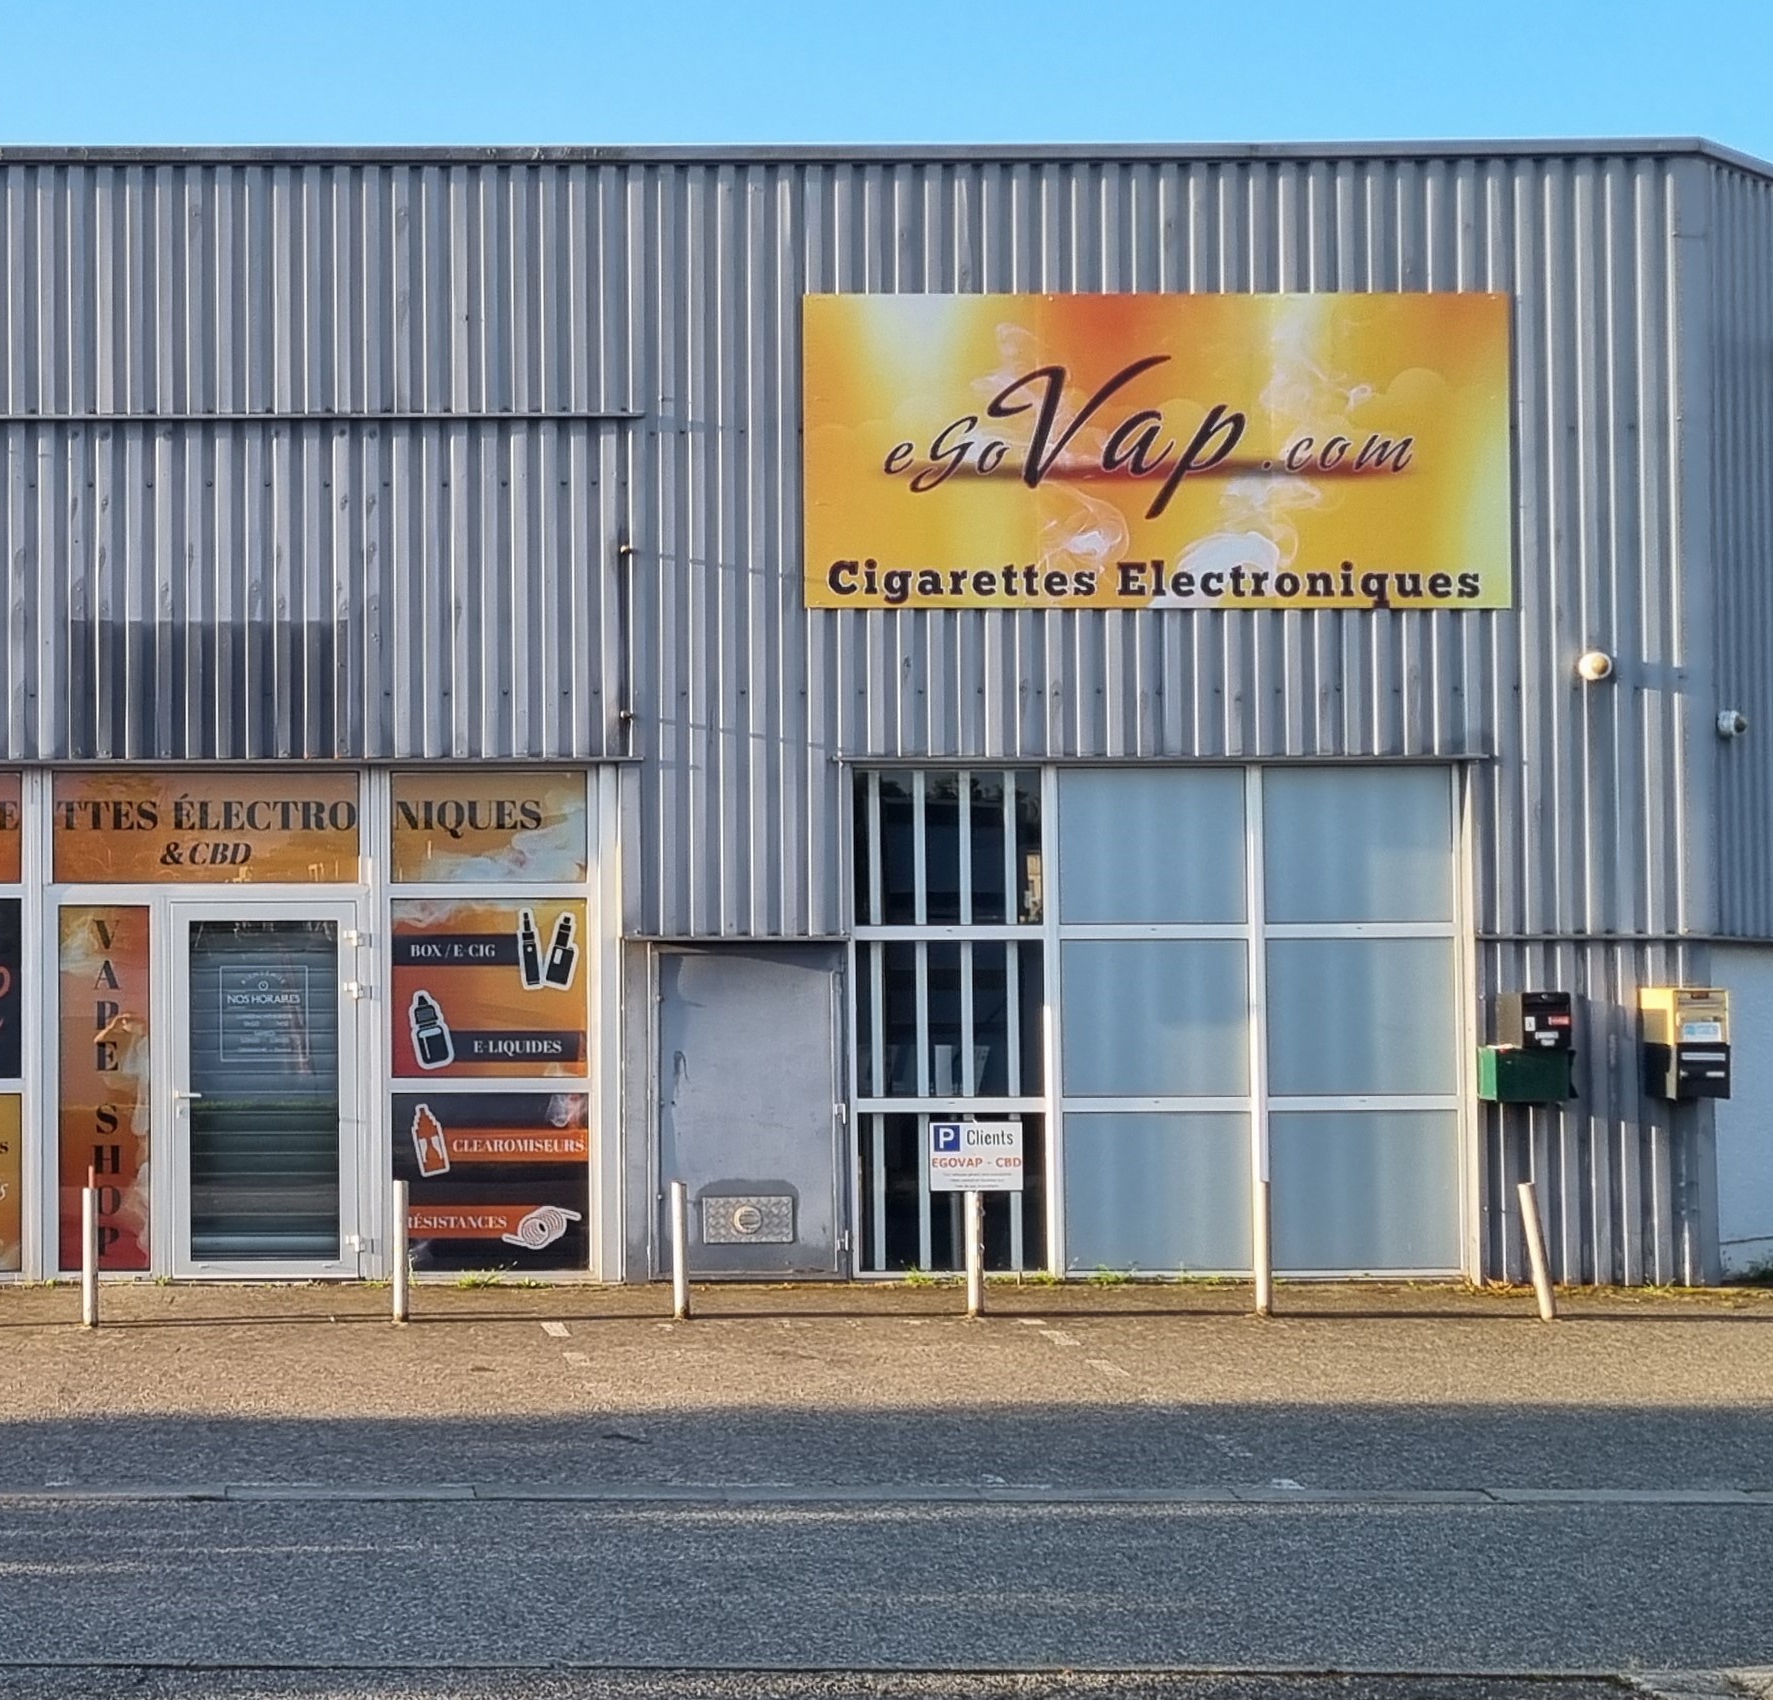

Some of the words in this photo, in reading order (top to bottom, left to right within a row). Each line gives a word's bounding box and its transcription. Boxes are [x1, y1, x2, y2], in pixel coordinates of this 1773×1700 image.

[828, 558, 1096, 604] Cigarettes
[1116, 558, 1480, 612] Electroniques
[410, 944, 442, 958] BOX
[94, 919, 121, 1072] VAPE
[227, 994, 249, 1004] NOS
[473, 1039, 562, 1054] E-LIQUIDES
[966, 1129, 1014, 1146] Clients
[452, 1138, 585, 1153] CLEAROMISEURS
[931, 1157, 983, 1168] EGOVAP
[995, 1157, 1022, 1168] CBD
[93, 1104, 121, 1256] SHOP
